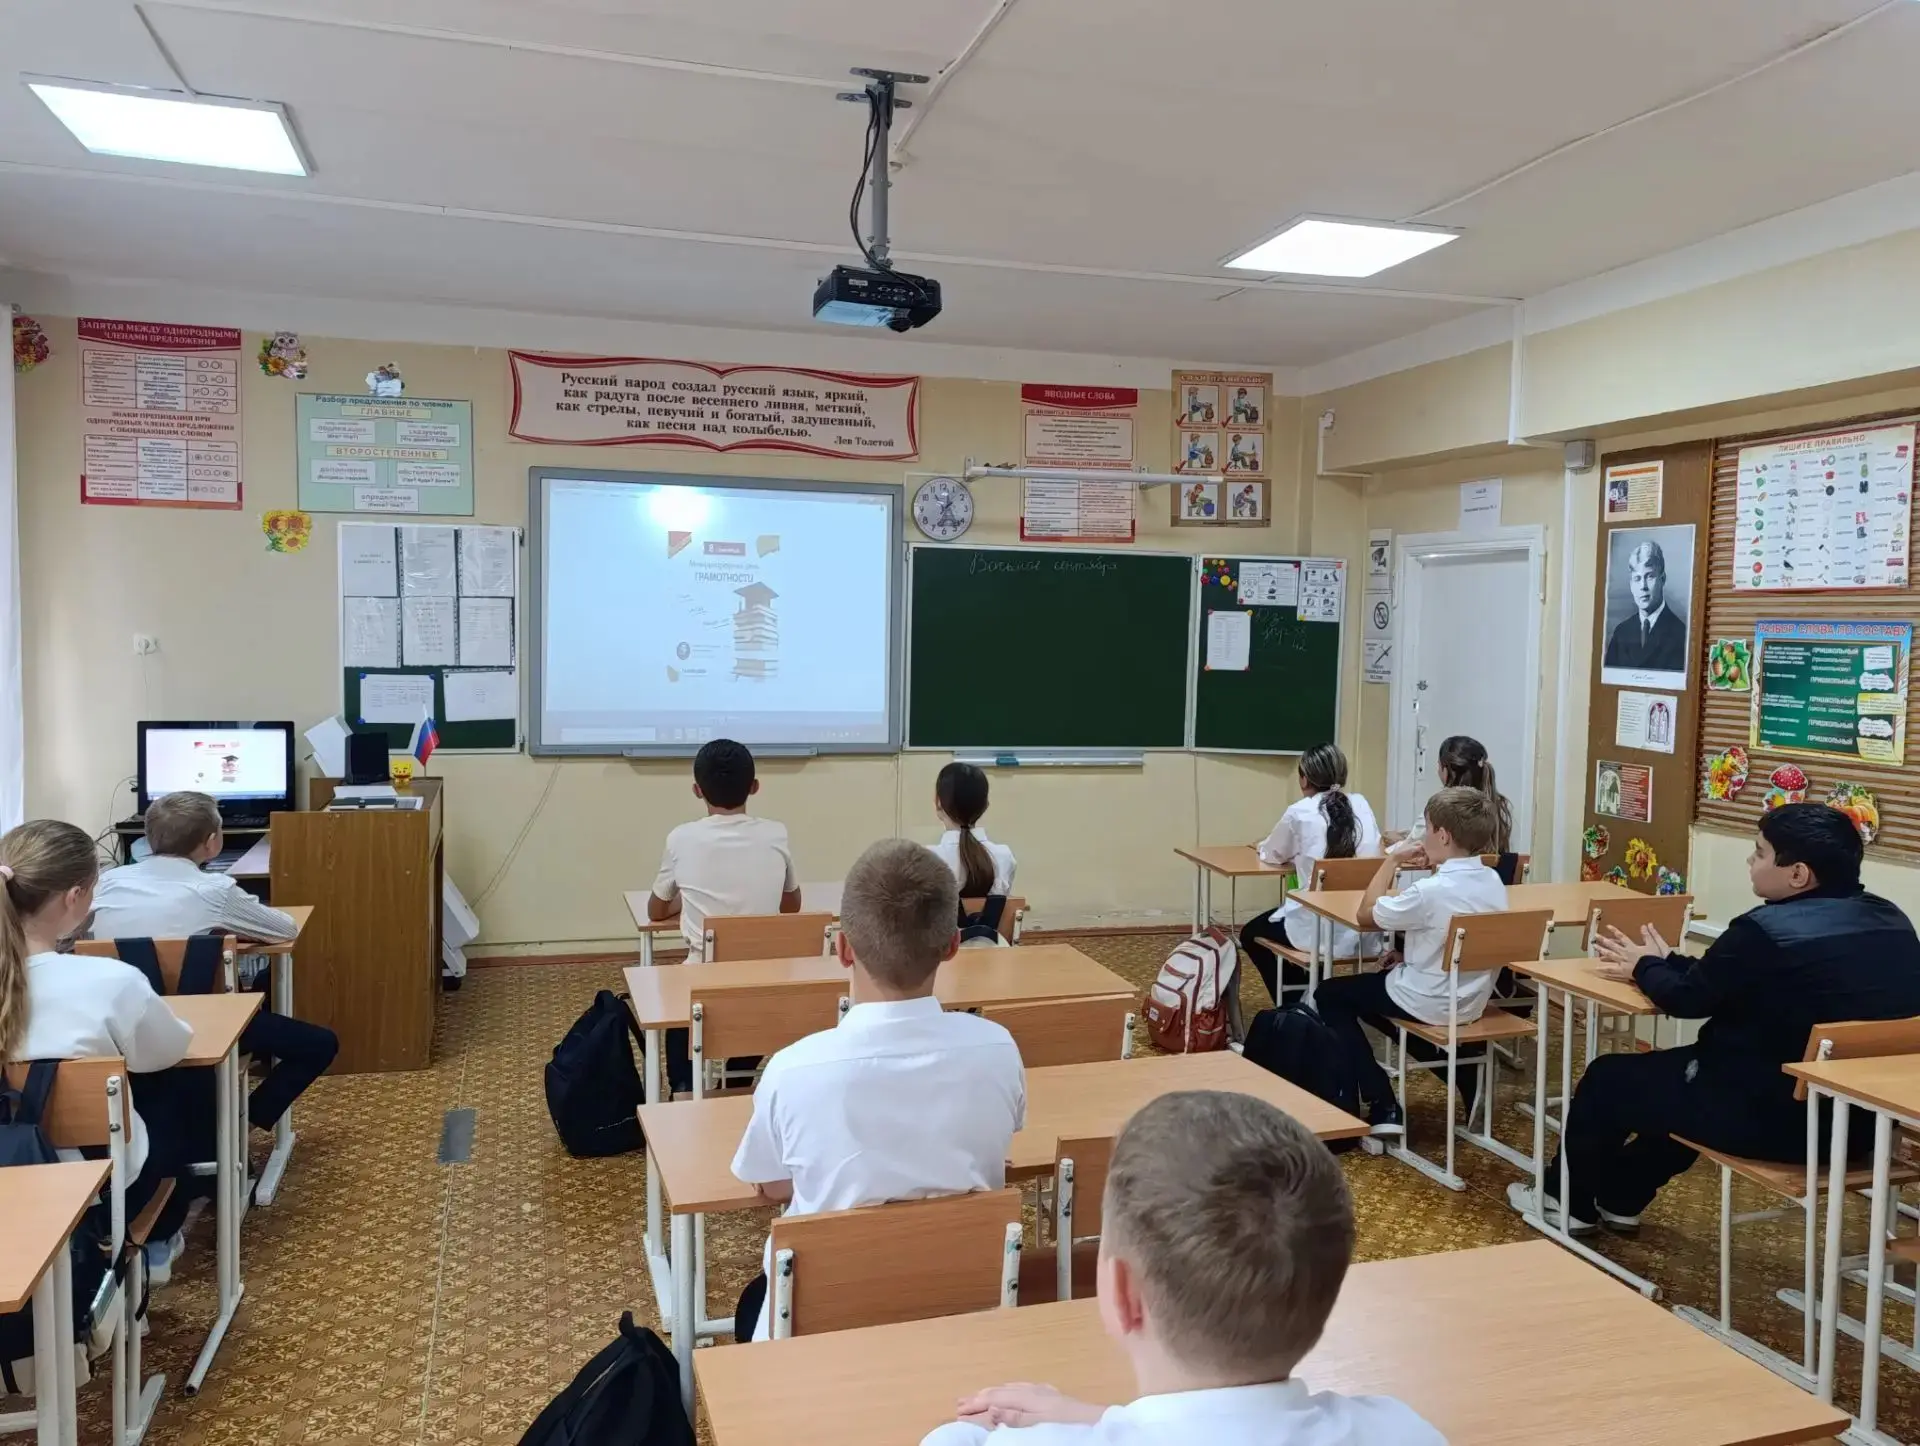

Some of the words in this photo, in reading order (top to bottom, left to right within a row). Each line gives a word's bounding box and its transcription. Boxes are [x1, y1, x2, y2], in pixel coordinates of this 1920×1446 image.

[81, 320, 125, 331] ЗАПЯТАЯ
[126, 325, 161, 334] МЕЖДУ
[164, 326, 239, 339] ОДНОРОДНЫМИ
[103, 331, 148, 342] ЧЛЕНАМИ
[150, 335, 217, 346] ПРЕДЛОЖЕНИЯ
[561, 372, 618, 387] Русский
[625, 378, 666, 391] народ
[672, 380, 717, 392] создал
[723, 384, 776, 397] русский
[782, 388, 819, 401] язык,
[824, 390, 868, 403] яркий,
[1043, 389, 1087, 400] ВВОДНЫЕ
[1087, 391, 1116, 401] СЛОВА
[315, 395, 348, 405] Разбор
[349, 397, 407, 408] предложения
[421, 401, 454, 409] членам
[563, 388, 588, 398] как
[595, 390, 640, 403] радуга
[647, 393, 686, 404] после
[692, 396, 759, 409] весеннего
[764, 400, 809, 412] ливня,
[815, 404, 866, 416] меткий,
[112, 411, 138, 419] ЗНАКИ
[139, 412, 194, 421] ПРЕПИНАНИЯ
[360, 408, 413, 417] ГЛАВНЫЕ
[555, 402, 581, 412] как
[587, 403, 641, 416] стрелы,
[648, 406, 704, 419] певучий
[711, 410, 719, 419] и
[725, 409, 785, 424] богатый,
[791, 415, 876, 429] задушевный,
[86, 417, 143, 427] ОДНОРОДНЫХ
[145, 420, 175, 428] ЧЛЕНАХ
[176, 422, 235, 431] ПРЕДЛОЖЕНИЯ
[626, 419, 651, 429] как
[657, 420, 696, 431] песня
[703, 424, 727, 434] над
[732, 424, 812, 438] колыбелью.
[180, 430, 213, 438] СЛОВОМ
[834, 435, 854, 446] Лев
[1778, 442, 1813, 453] ПИШИТЕ
[1814, 434, 1866, 448] ПРАВИЛЬНО
[335, 447, 439, 459] ВТОРОСТЕПЕННЫЕ
[939, 483, 947, 491] 12
[959, 493, 965, 501] 2
[922, 516, 929, 525] 8
[959, 517, 965, 525] 4
[1053, 555, 1118, 577] сентября
[695, 572, 754, 583] ГРАМОТНОСТИ
[1759, 623, 1795, 634] РАЗБОР
[1798, 624, 1834, 635] СЛОВА
[1837, 625, 1853, 635] ПО
[1855, 625, 1907, 636] СОСТАВУ
[1812, 647, 1859, 656] ПРИШКОЛЬНЫЙ
[1810, 676, 1856, 686] ПРИШКОЛЬНЫЙ
[1809, 695, 1855, 705] ПРИШКОЛЬНЫЙ
[1808, 719, 1854, 729] ПРИШКОЛЬНЫЙ
[1807, 734, 1853, 745] ПРИШКОЛЬНЫЙ
